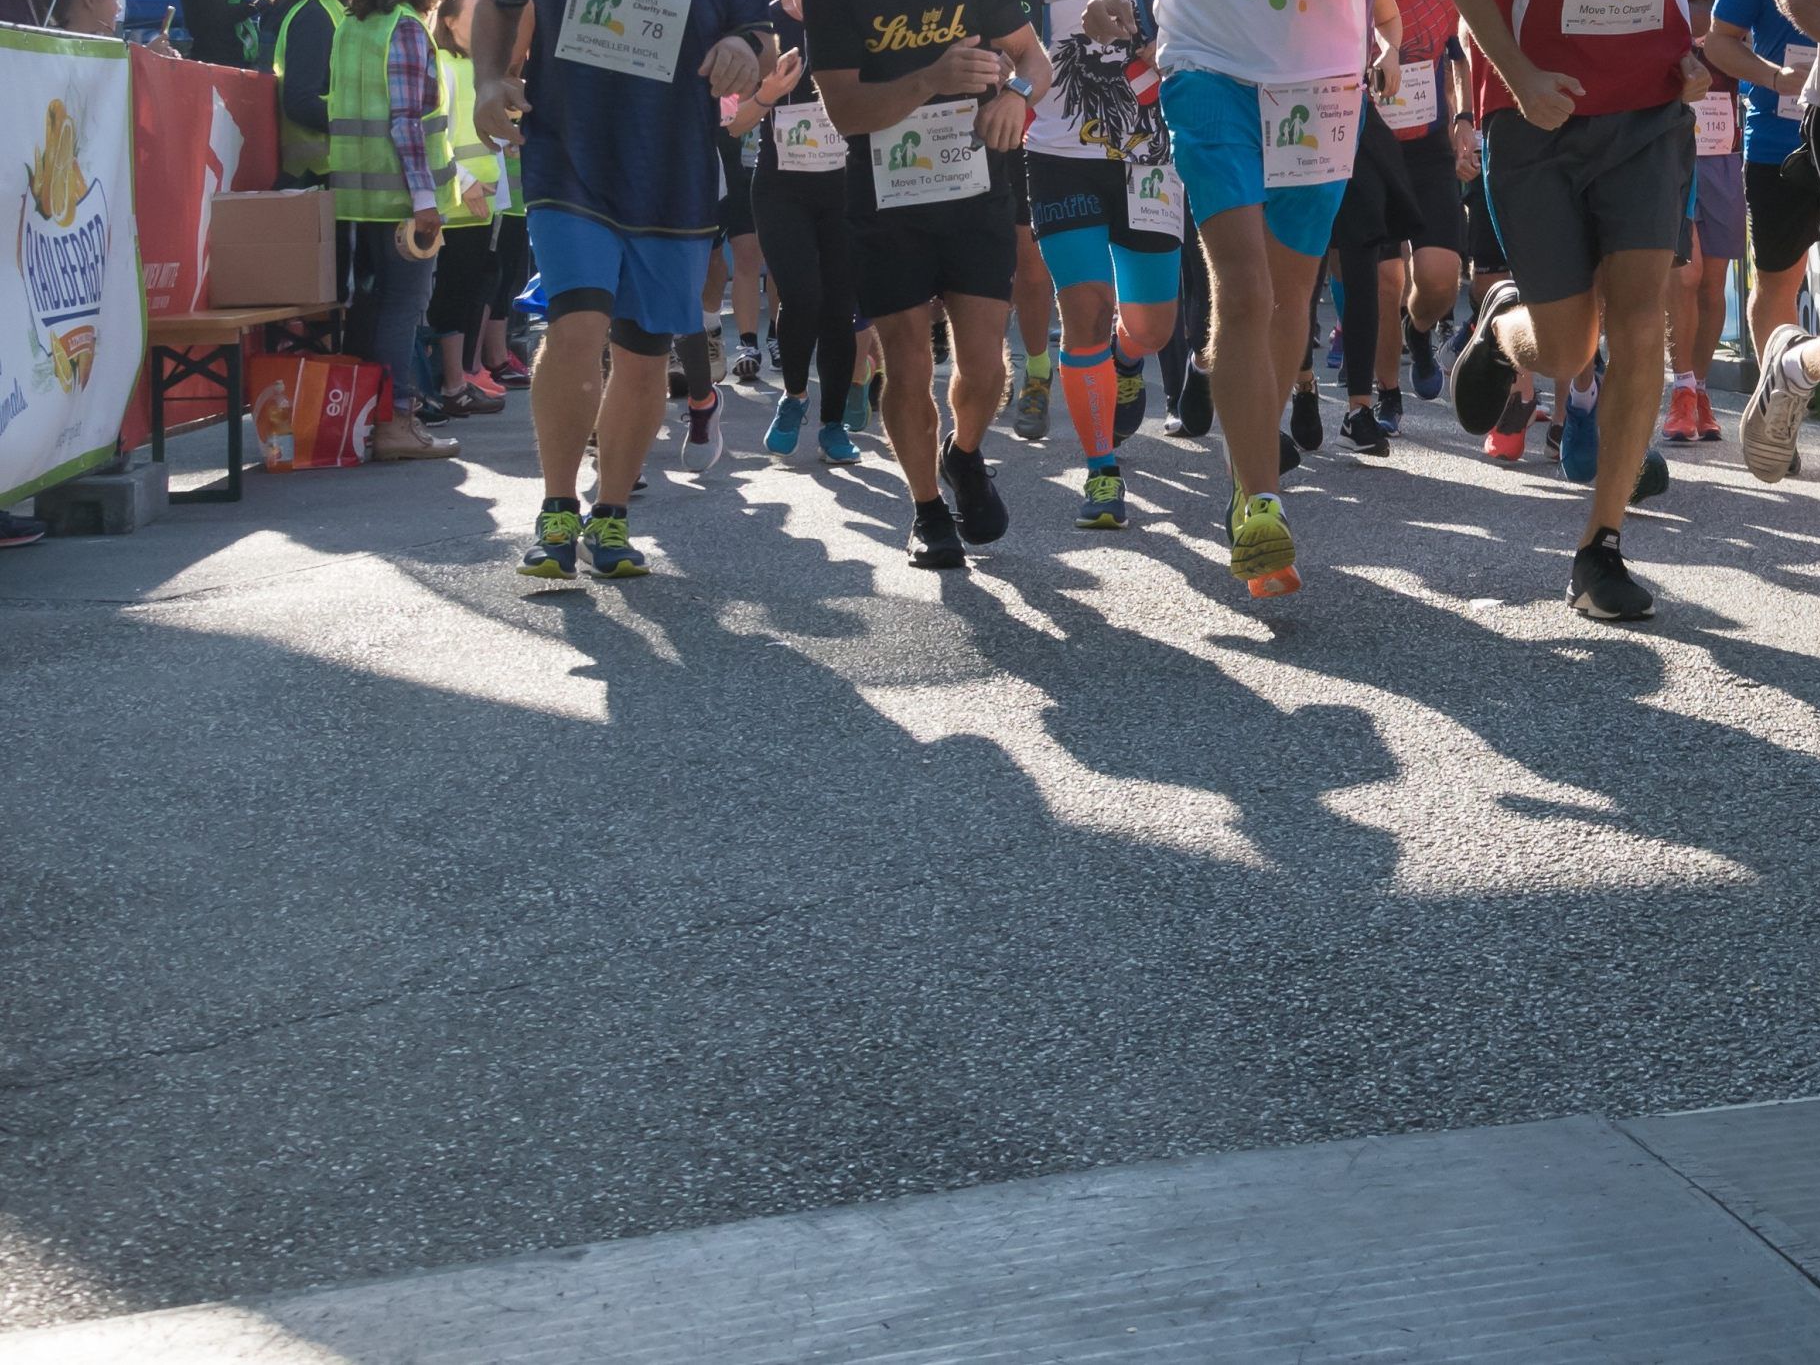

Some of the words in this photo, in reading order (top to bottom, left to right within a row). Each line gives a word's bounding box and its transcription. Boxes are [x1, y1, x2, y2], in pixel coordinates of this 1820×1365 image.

[632, 1, 661, 16] Charity
[1579, 4, 1605, 15] Move
[1609, 4, 1620, 15] To
[641, 19, 664, 40] 78
[864, 3, 967, 53] Ströck
[576, 33, 630, 53] SCHNELLER
[632, 46, 659, 60] MICHL
[1413, 89, 1427, 103] 44
[1315, 102, 1340, 112] Vienna
[1319, 111, 1343, 121] Charity
[1331, 124, 1346, 143] 15
[1706, 121, 1726, 132] 1143
[931, 133, 958, 143] Charity
[940, 146, 972, 165] 926
[1296, 156, 1318, 166] Team
[890, 178, 917, 189] Move
[919, 175, 932, 185] To
[933, 171, 973, 184] Change!
[1140, 205, 1160, 217] Move
